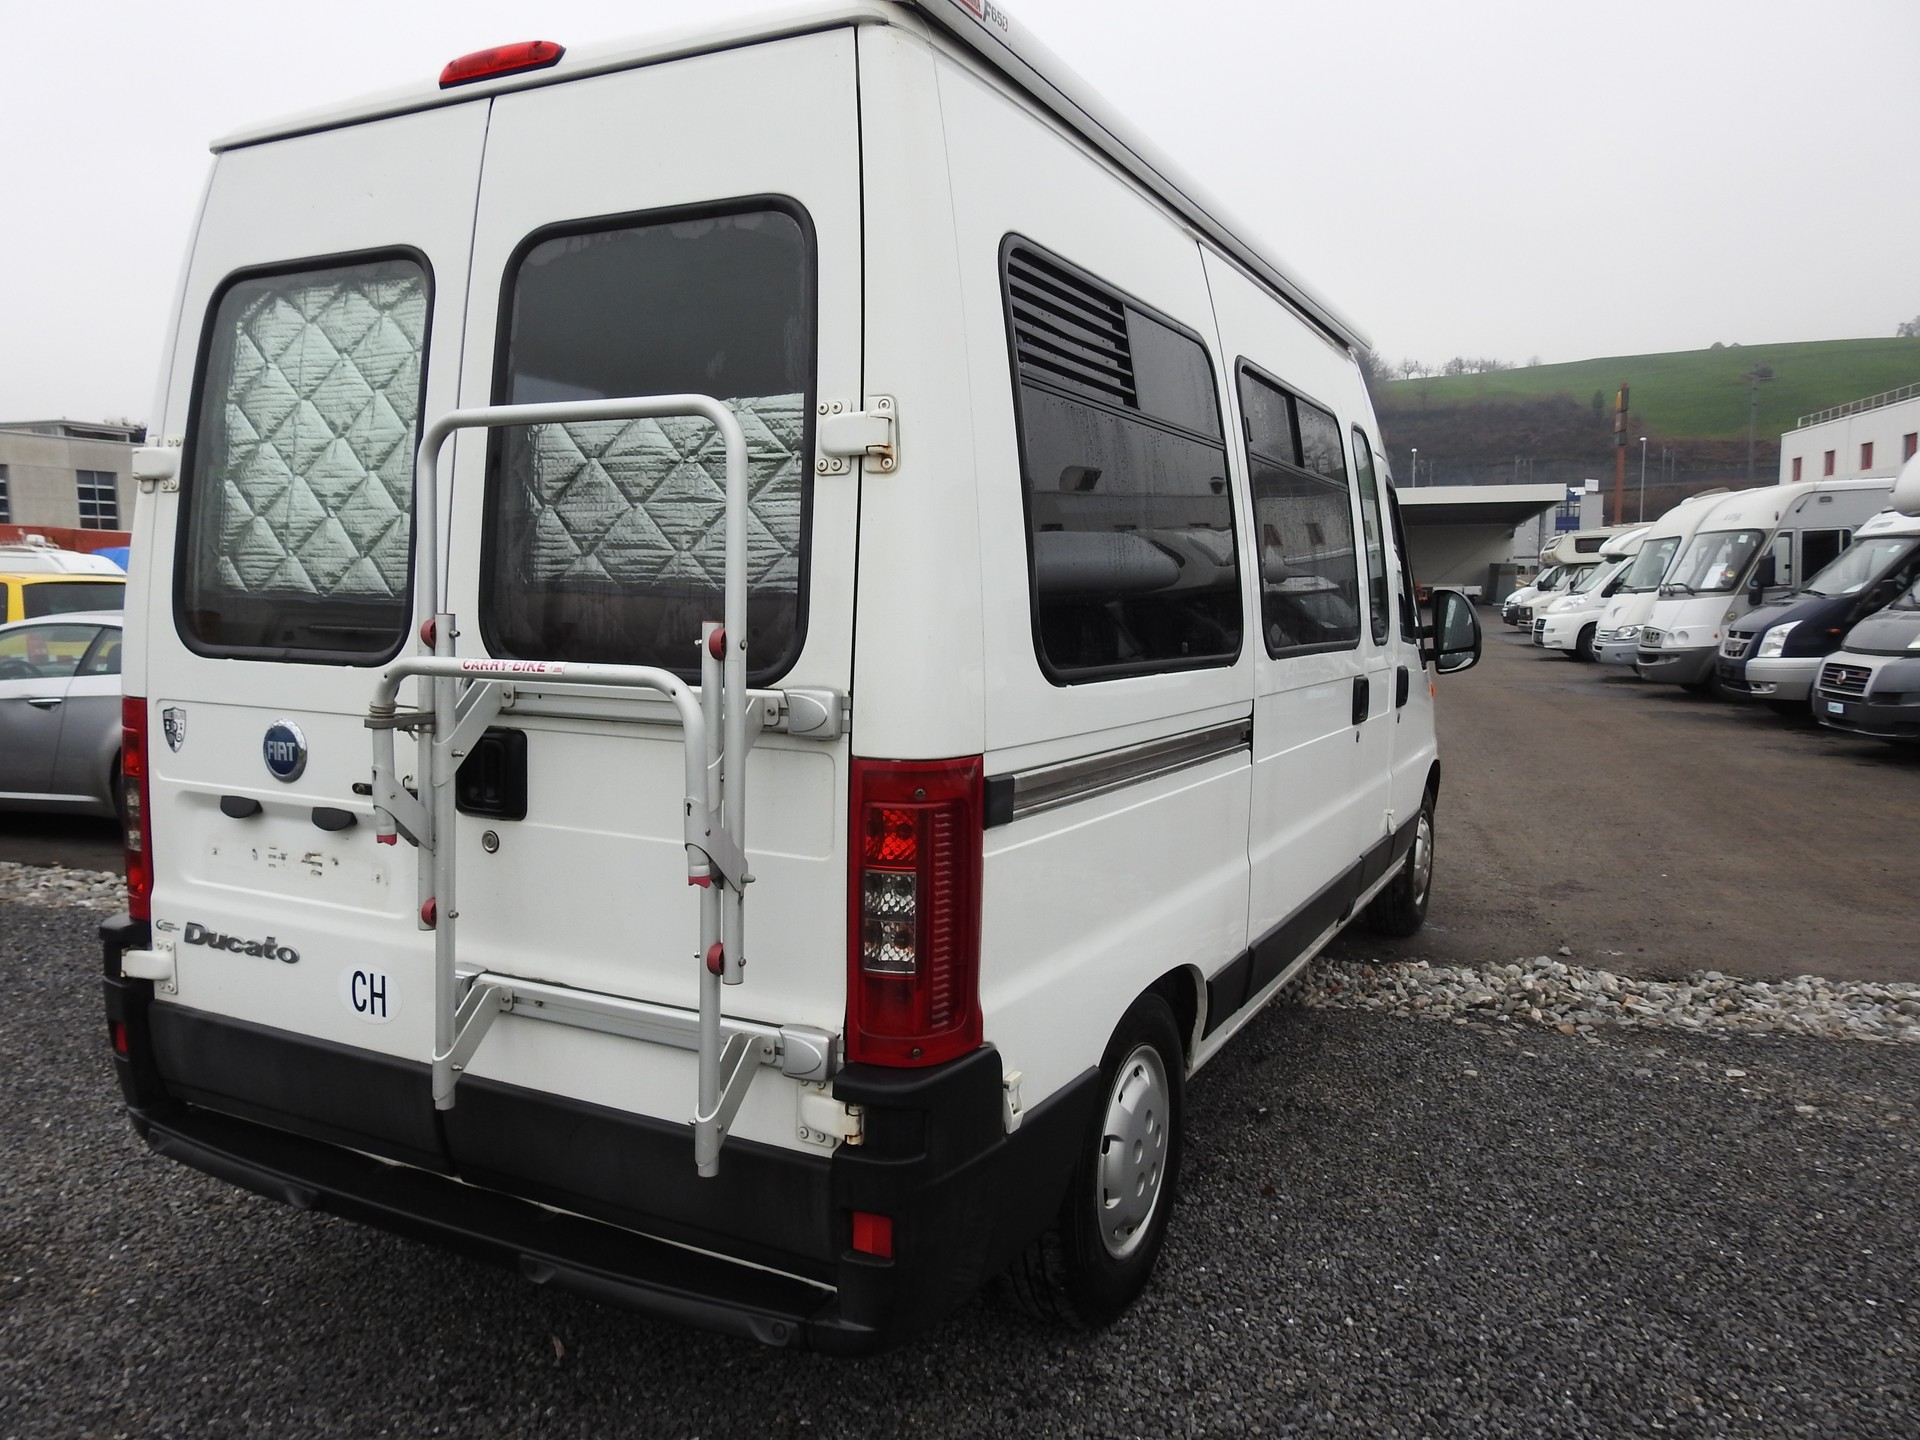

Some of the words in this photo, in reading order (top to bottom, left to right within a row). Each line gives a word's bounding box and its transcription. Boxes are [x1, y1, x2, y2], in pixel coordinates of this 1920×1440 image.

[462, 659, 547, 673] CARRY-BIKE
[267, 740, 296, 762] FIAT
[184, 921, 301, 964] Ducato
[351, 970, 387, 1018] CH
